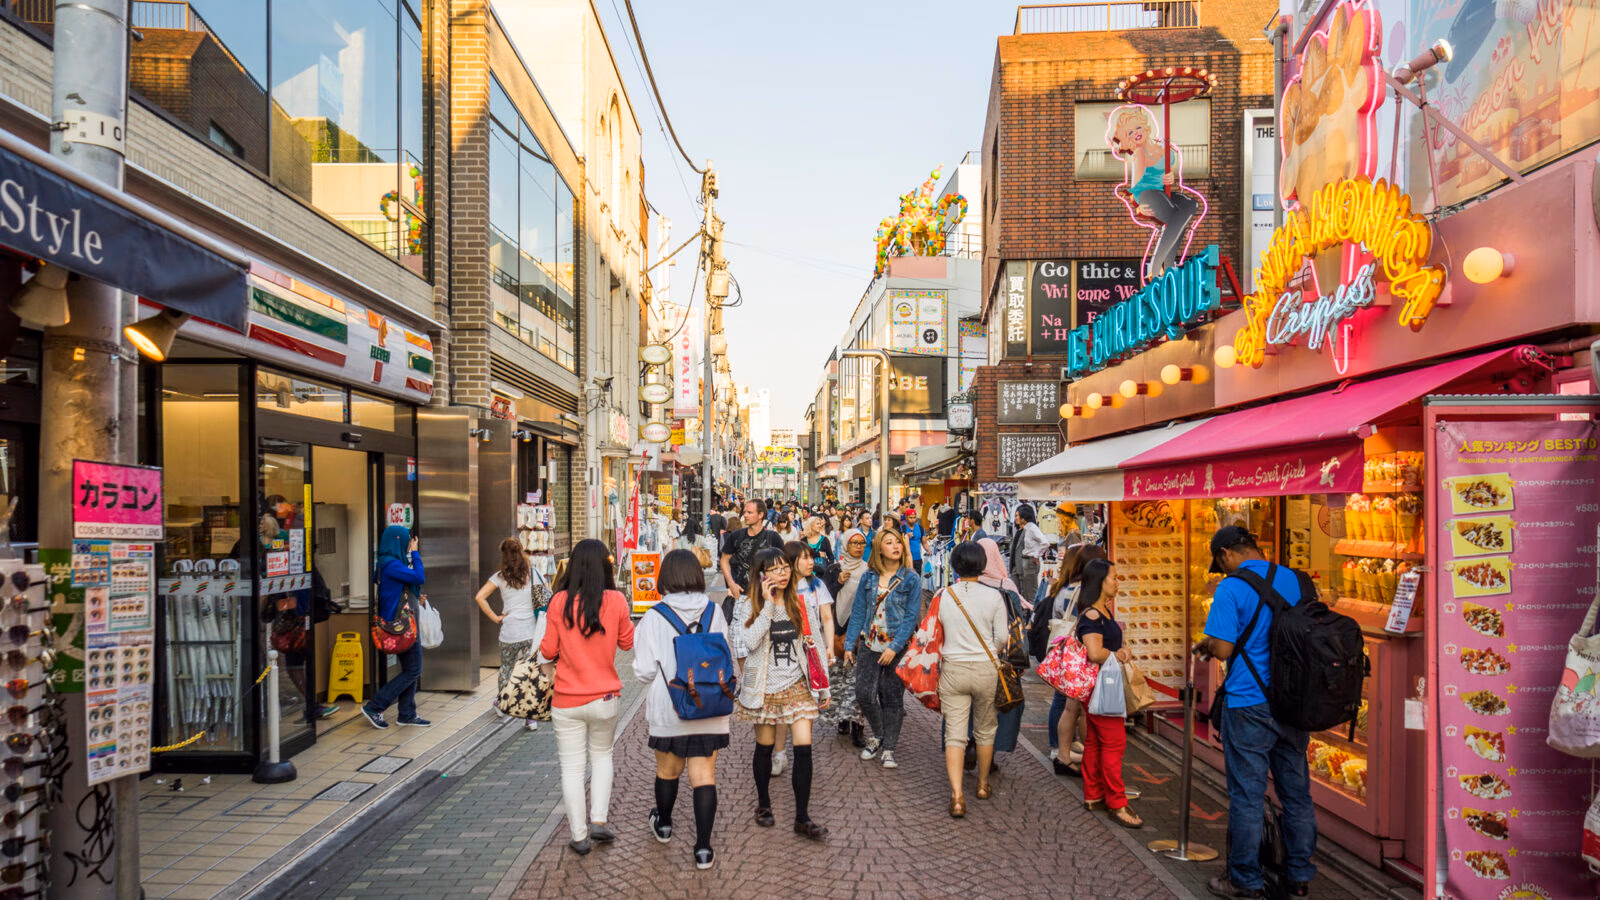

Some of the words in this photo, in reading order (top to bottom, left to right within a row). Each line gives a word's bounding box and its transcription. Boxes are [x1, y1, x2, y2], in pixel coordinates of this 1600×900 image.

[0, 178, 104, 265] Style
[1040, 262, 1069, 277] Go
[1081, 262, 1121, 279] thic
[1124, 268, 1136, 278] &
[1041, 283, 1068, 298] Vivi
[1077, 288, 1110, 302] enne
[1092, 246, 1220, 370] BURLESQUE
[1007, 276, 1025, 342] 買取委託
[1041, 315, 1062, 327] Na
[1458, 440, 1540, 453] 人気ランキング
[1544, 438, 1597, 450] BEST10
[1227, 471, 1246, 487] Come
[1280, 458, 1306, 490] Girls
[80, 480, 157, 511] カラコン
